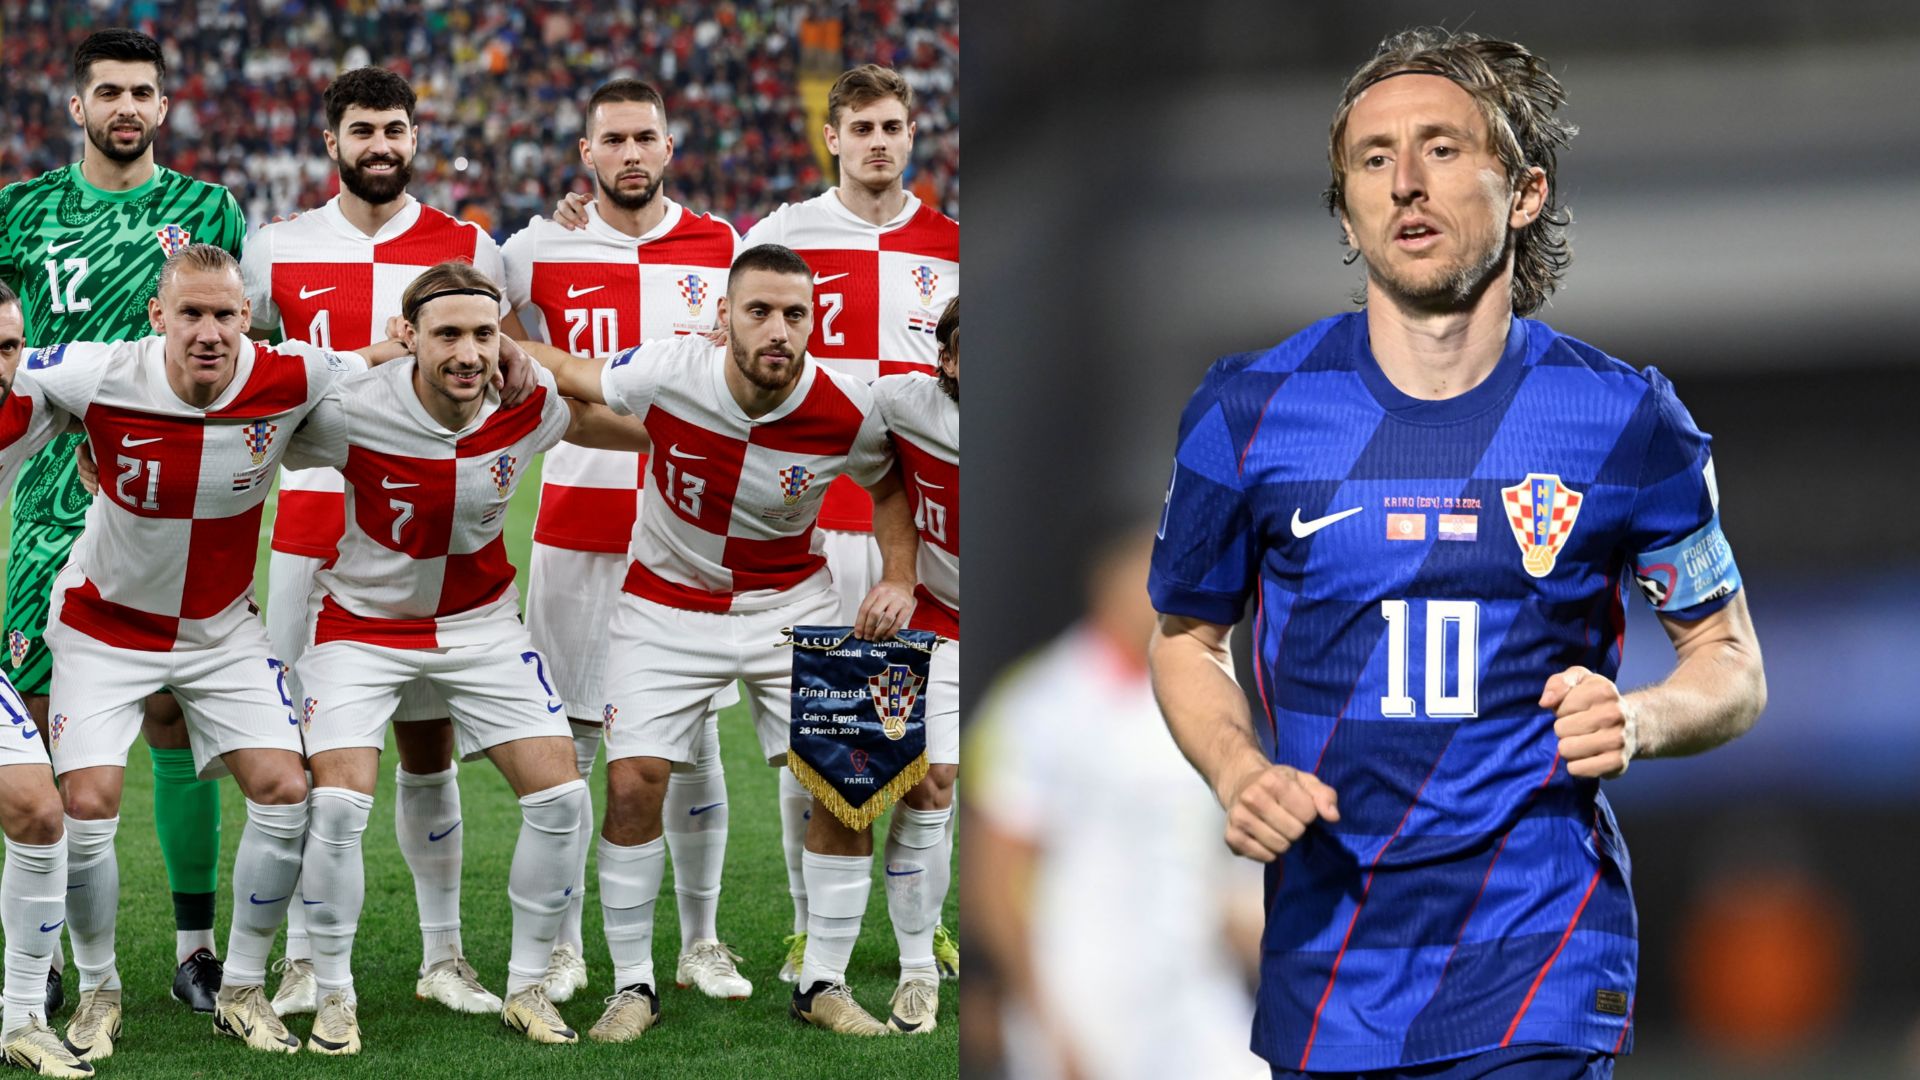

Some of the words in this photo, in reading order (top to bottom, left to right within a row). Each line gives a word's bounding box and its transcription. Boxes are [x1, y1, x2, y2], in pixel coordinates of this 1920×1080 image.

[45, 258, 91, 313] 12
[564, 308, 618, 359] 20
[819, 293, 845, 346] 2
[116, 453, 161, 511] 21
[665, 460, 706, 520] 13
[1384, 497, 1414, 508] KAIRO
[389, 498, 415, 544] 7
[914, 484, 947, 544] 10
[1536, 484, 1549, 535] HNS
[870, 649, 887, 659] Cup
[1380, 599, 1480, 718] 10
[799, 686, 828, 699] Final
[829, 688, 867, 700] match
[891, 671, 902, 709] HNS
[799, 726, 811, 735] 26
[811, 726, 838, 735] March
[839, 726, 860, 735] 2024
[802, 712, 830, 723] Cairo,
[832, 713, 858, 724] Egypt
[844, 777, 874, 785] FAMILY
